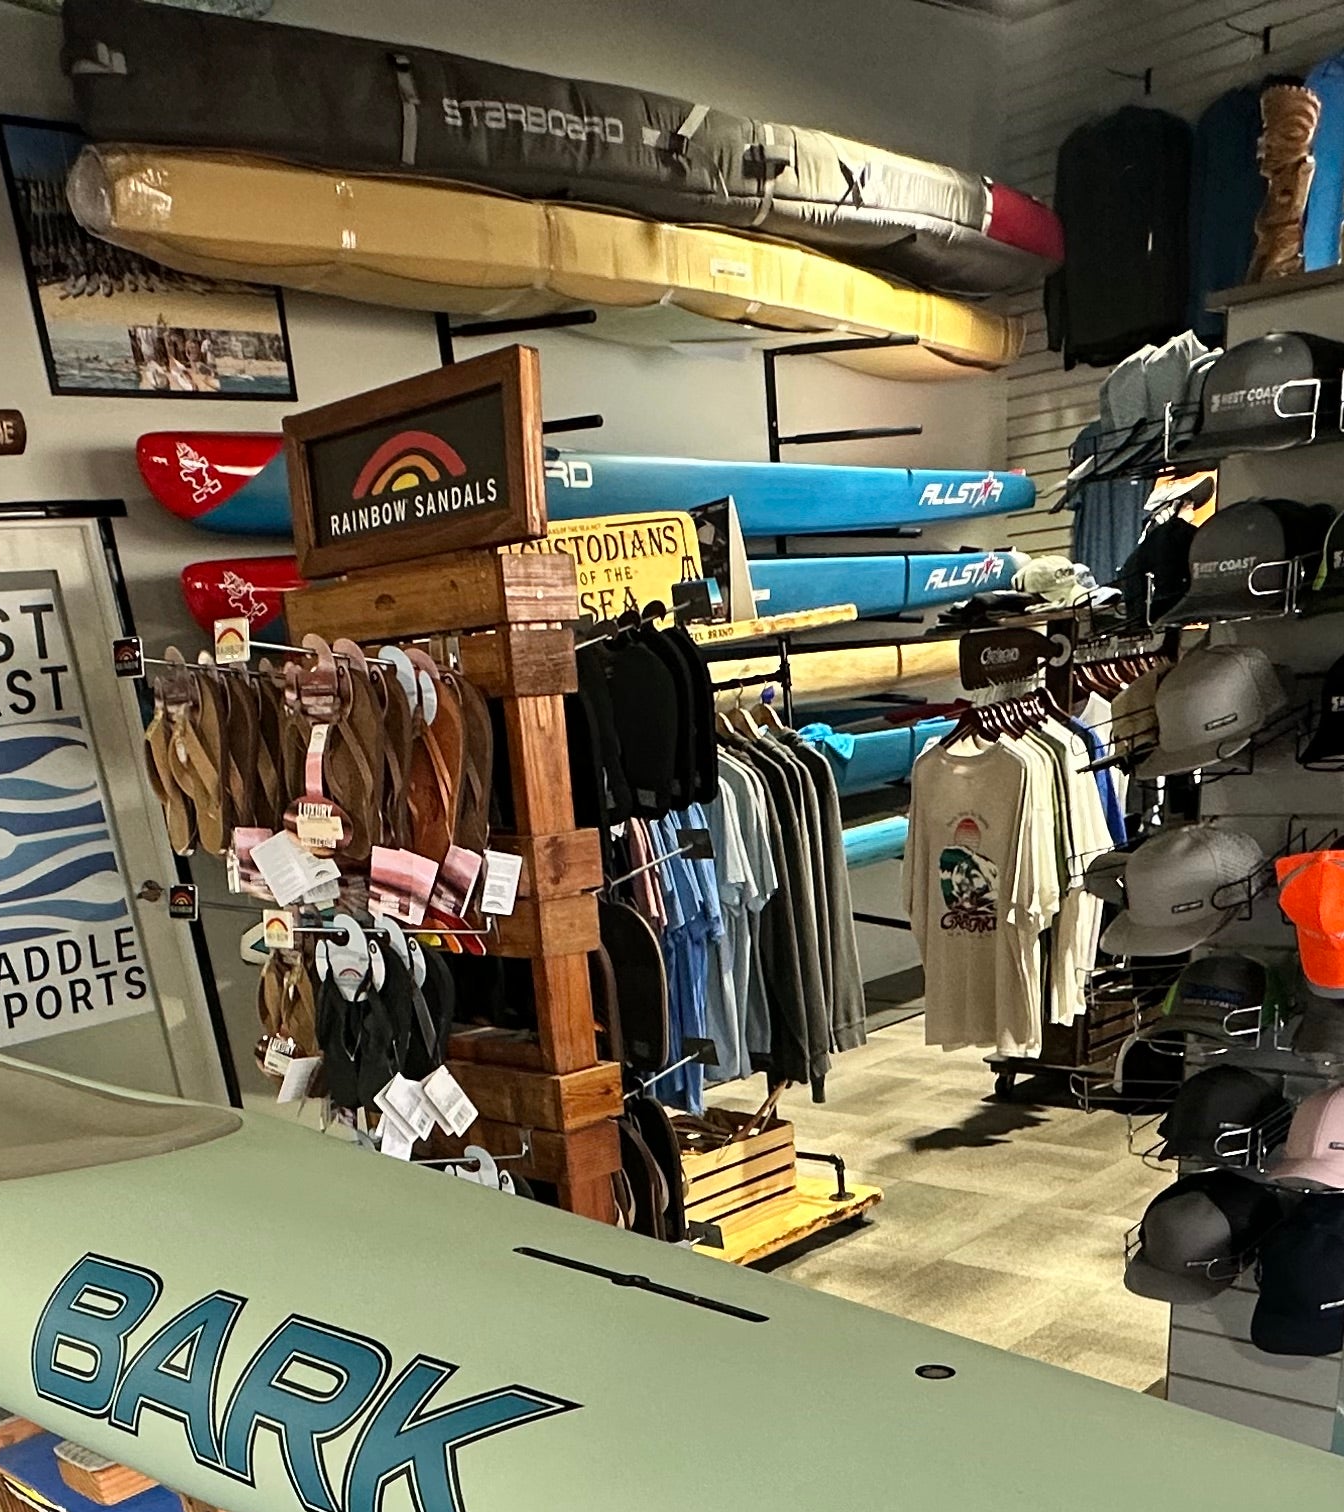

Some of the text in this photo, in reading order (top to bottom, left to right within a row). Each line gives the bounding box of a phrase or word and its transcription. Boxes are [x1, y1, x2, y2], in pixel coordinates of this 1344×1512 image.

[330, 477, 498, 536] RAINBOW SANDALS
[580, 566, 634, 586] OF THE
[297, 802, 333, 819] LUXURY
